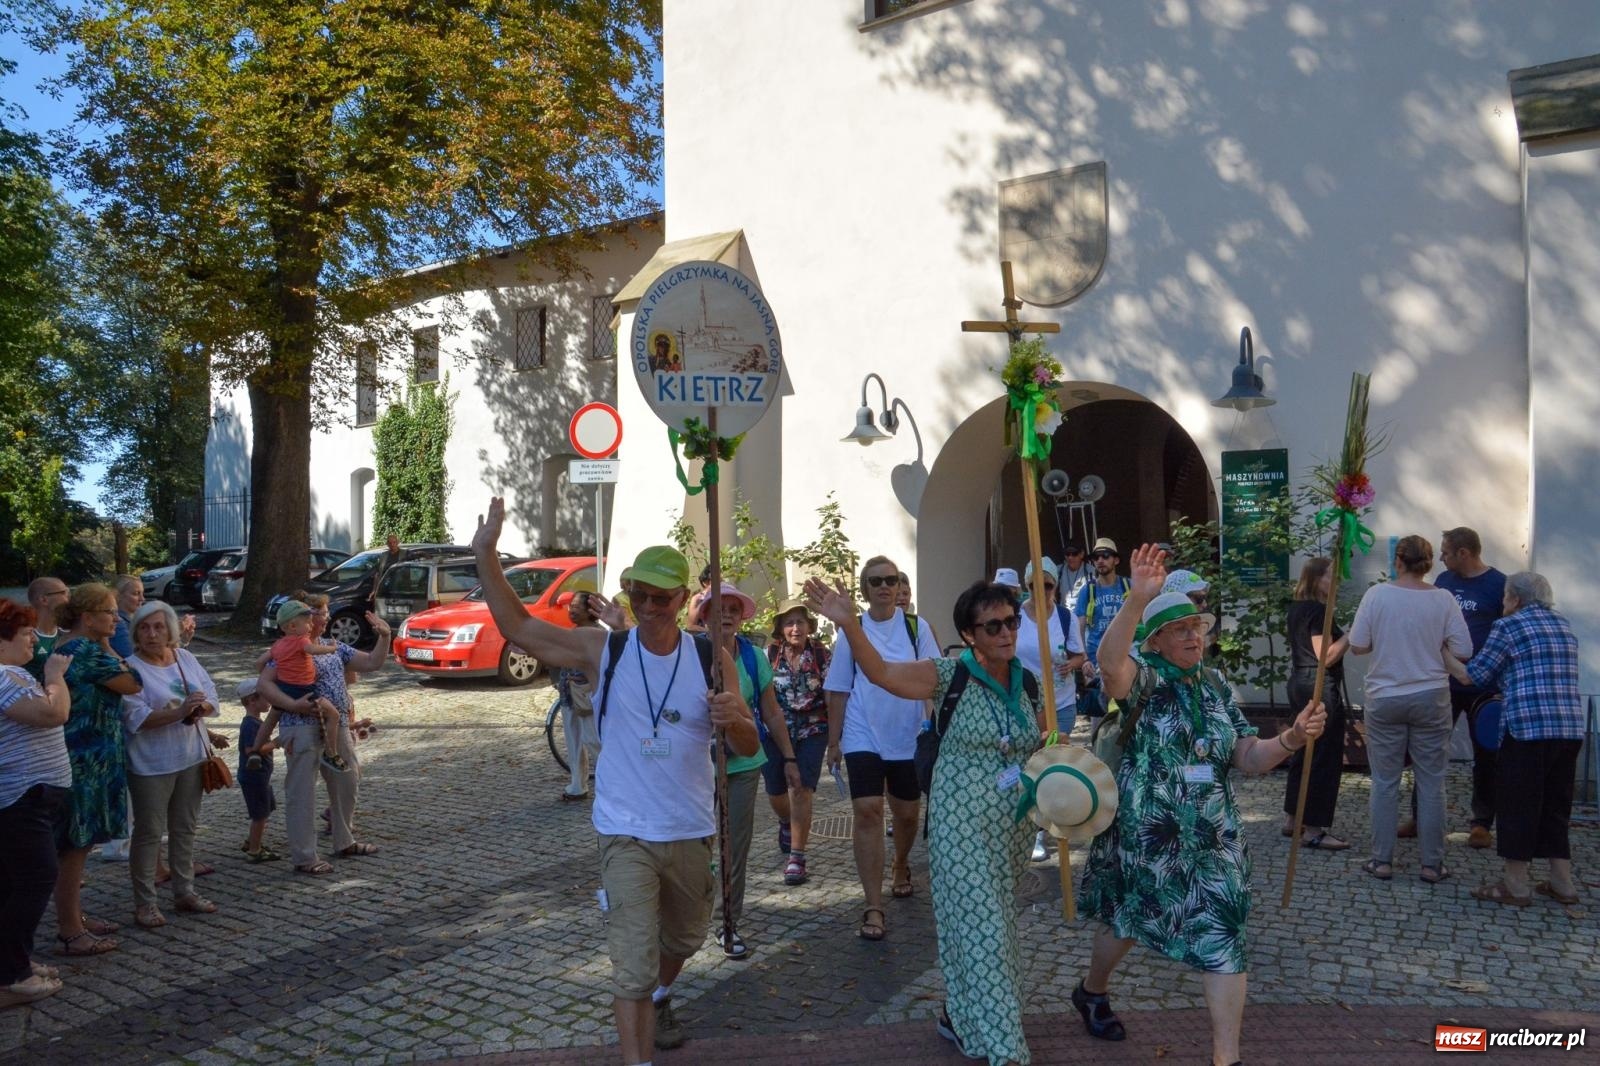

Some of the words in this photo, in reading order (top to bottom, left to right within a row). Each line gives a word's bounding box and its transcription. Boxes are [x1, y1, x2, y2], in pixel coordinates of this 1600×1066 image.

[635, 306, 654, 373] OPOLSKA
[649, 266, 729, 305] PIELGRZYMKA
[732, 276, 750, 296] NA
[658, 375, 764, 402] KIETRZ
[1225, 471, 1285, 481] MASZYNOWNIA
